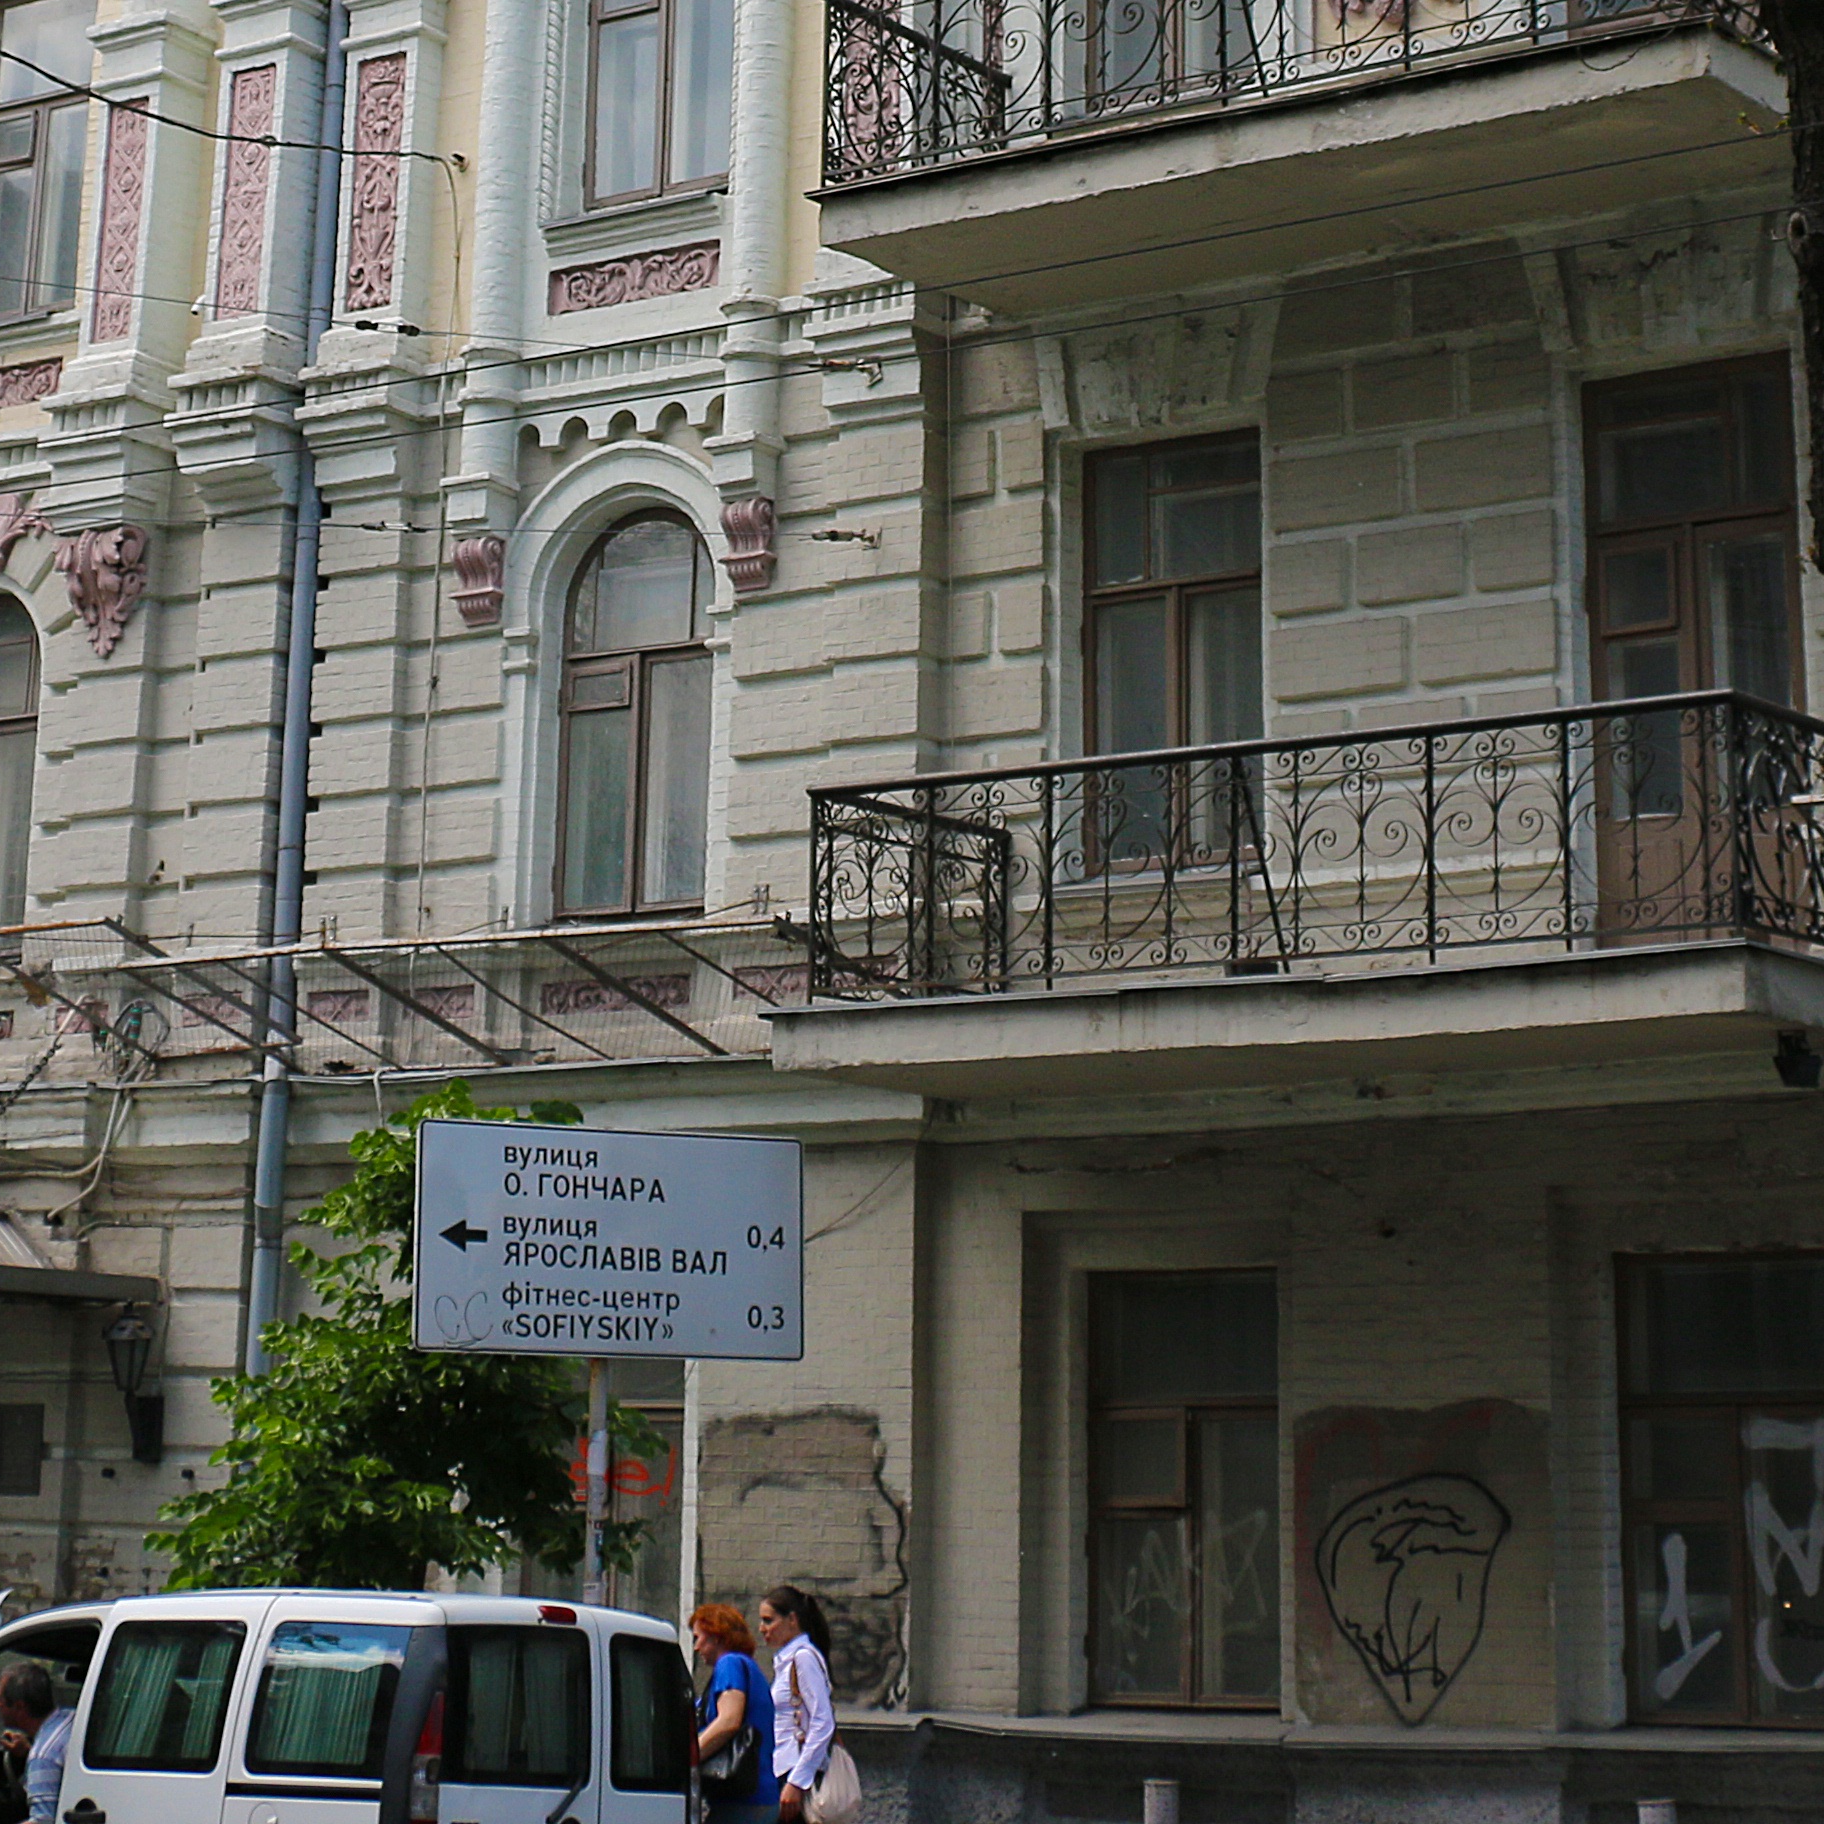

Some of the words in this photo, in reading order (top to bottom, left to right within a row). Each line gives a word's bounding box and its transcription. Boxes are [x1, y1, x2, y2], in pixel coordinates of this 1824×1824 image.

[504, 1146, 598, 1171] вулиця
[504, 1172, 528, 1196] О.
[539, 1173, 666, 1203] ГОНЧАРА
[503, 1216, 597, 1241] вулиця
[746, 1225, 785, 1253] 0,4
[503, 1241, 661, 1272] ЯРОСЛАВІВ
[672, 1248, 728, 1276] ВАЛ
[502, 1281, 680, 1317] фітнес-центр
[746, 1305, 785, 1332] 0,3
[502, 1313, 675, 1343] «SOFIYSKIY»
